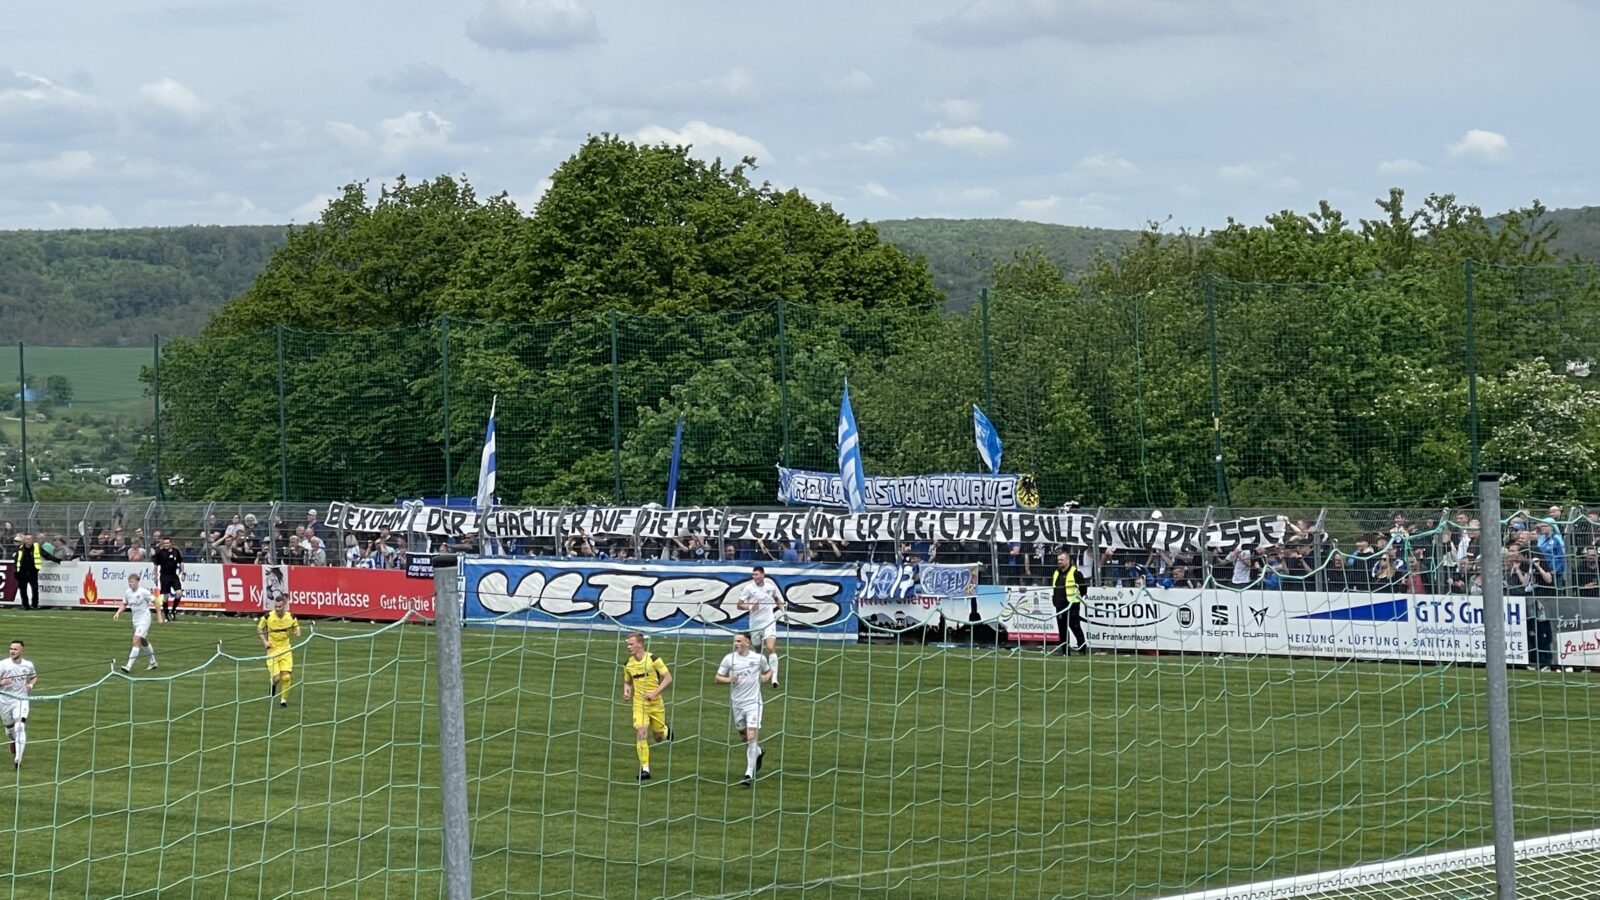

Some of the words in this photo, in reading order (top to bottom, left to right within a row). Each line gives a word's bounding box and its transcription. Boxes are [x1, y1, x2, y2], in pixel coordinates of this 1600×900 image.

[792, 475, 1016, 508] ROLADSTADTKURVE
[426, 509, 466, 536] DER
[591, 510, 632, 533] AUF
[774, 513, 851, 540] RENNT
[856, 513, 882, 540] ER
[1019, 514, 1112, 547] BULLEN
[1115, 522, 1160, 548] UND
[1165, 515, 1281, 552] PRESSE
[102, 567, 126, 580] Brand-
[249, 585, 369, 609] Kyusersparkasse
[381, 594, 397, 609] Gut
[414, 598, 430, 611] die
[1416, 601, 1455, 623] GTS
[1459, 602, 1520, 625] GmH
[1086, 632, 1099, 640] Bad
[1288, 634, 1335, 644] HEIZUNG
[1348, 634, 1399, 646] LÜFTUNG
[1413, 638, 1460, 649] SANITÄR
[1475, 641, 1523, 651] SEICE
